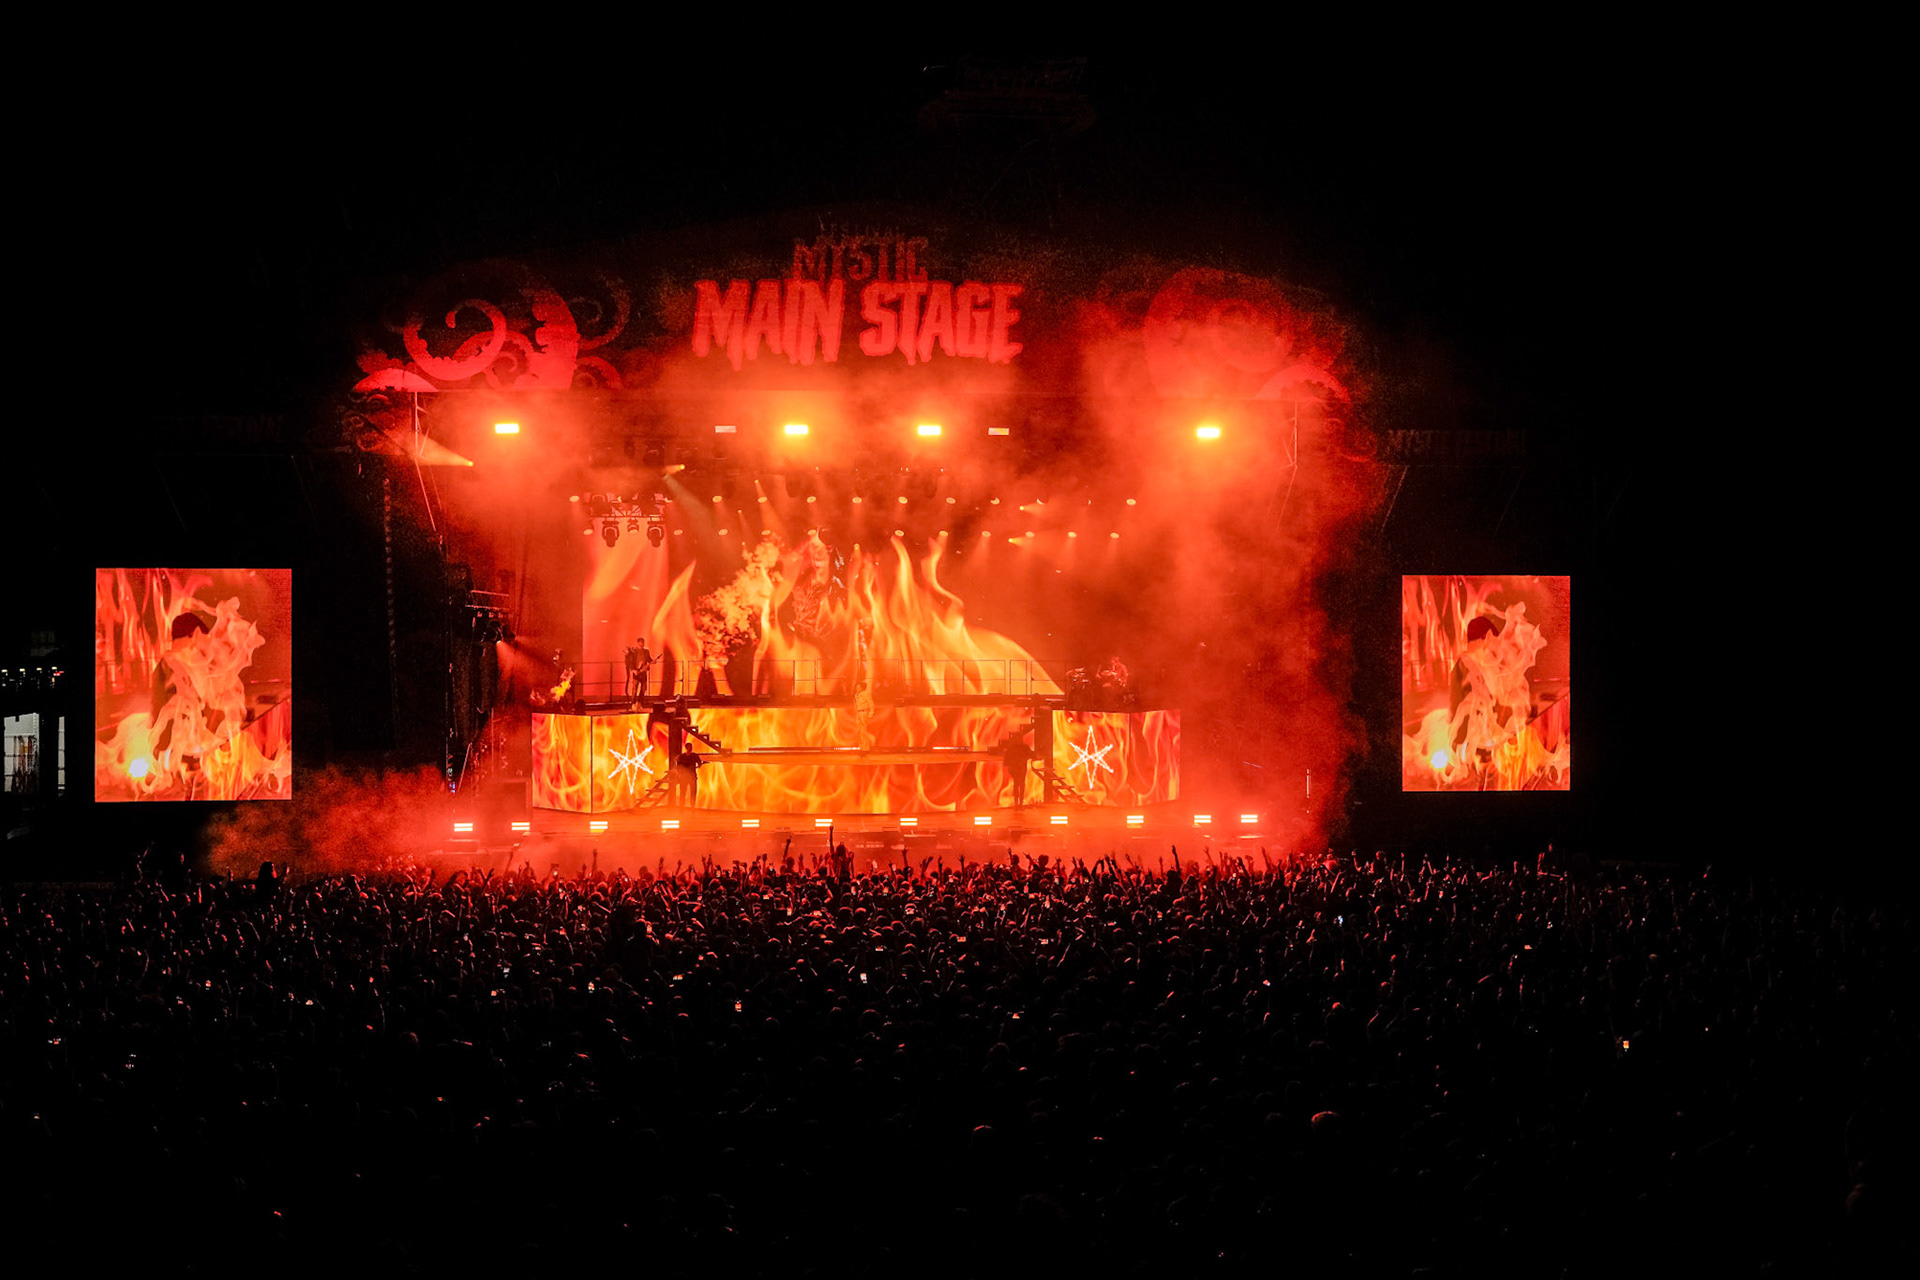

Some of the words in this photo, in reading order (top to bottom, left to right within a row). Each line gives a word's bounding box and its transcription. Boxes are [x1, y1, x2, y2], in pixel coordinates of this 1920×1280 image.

[792, 235, 929, 283] MYSTIC
[692, 279, 845, 371] MAIN
[860, 281, 1024, 366] STAGE
